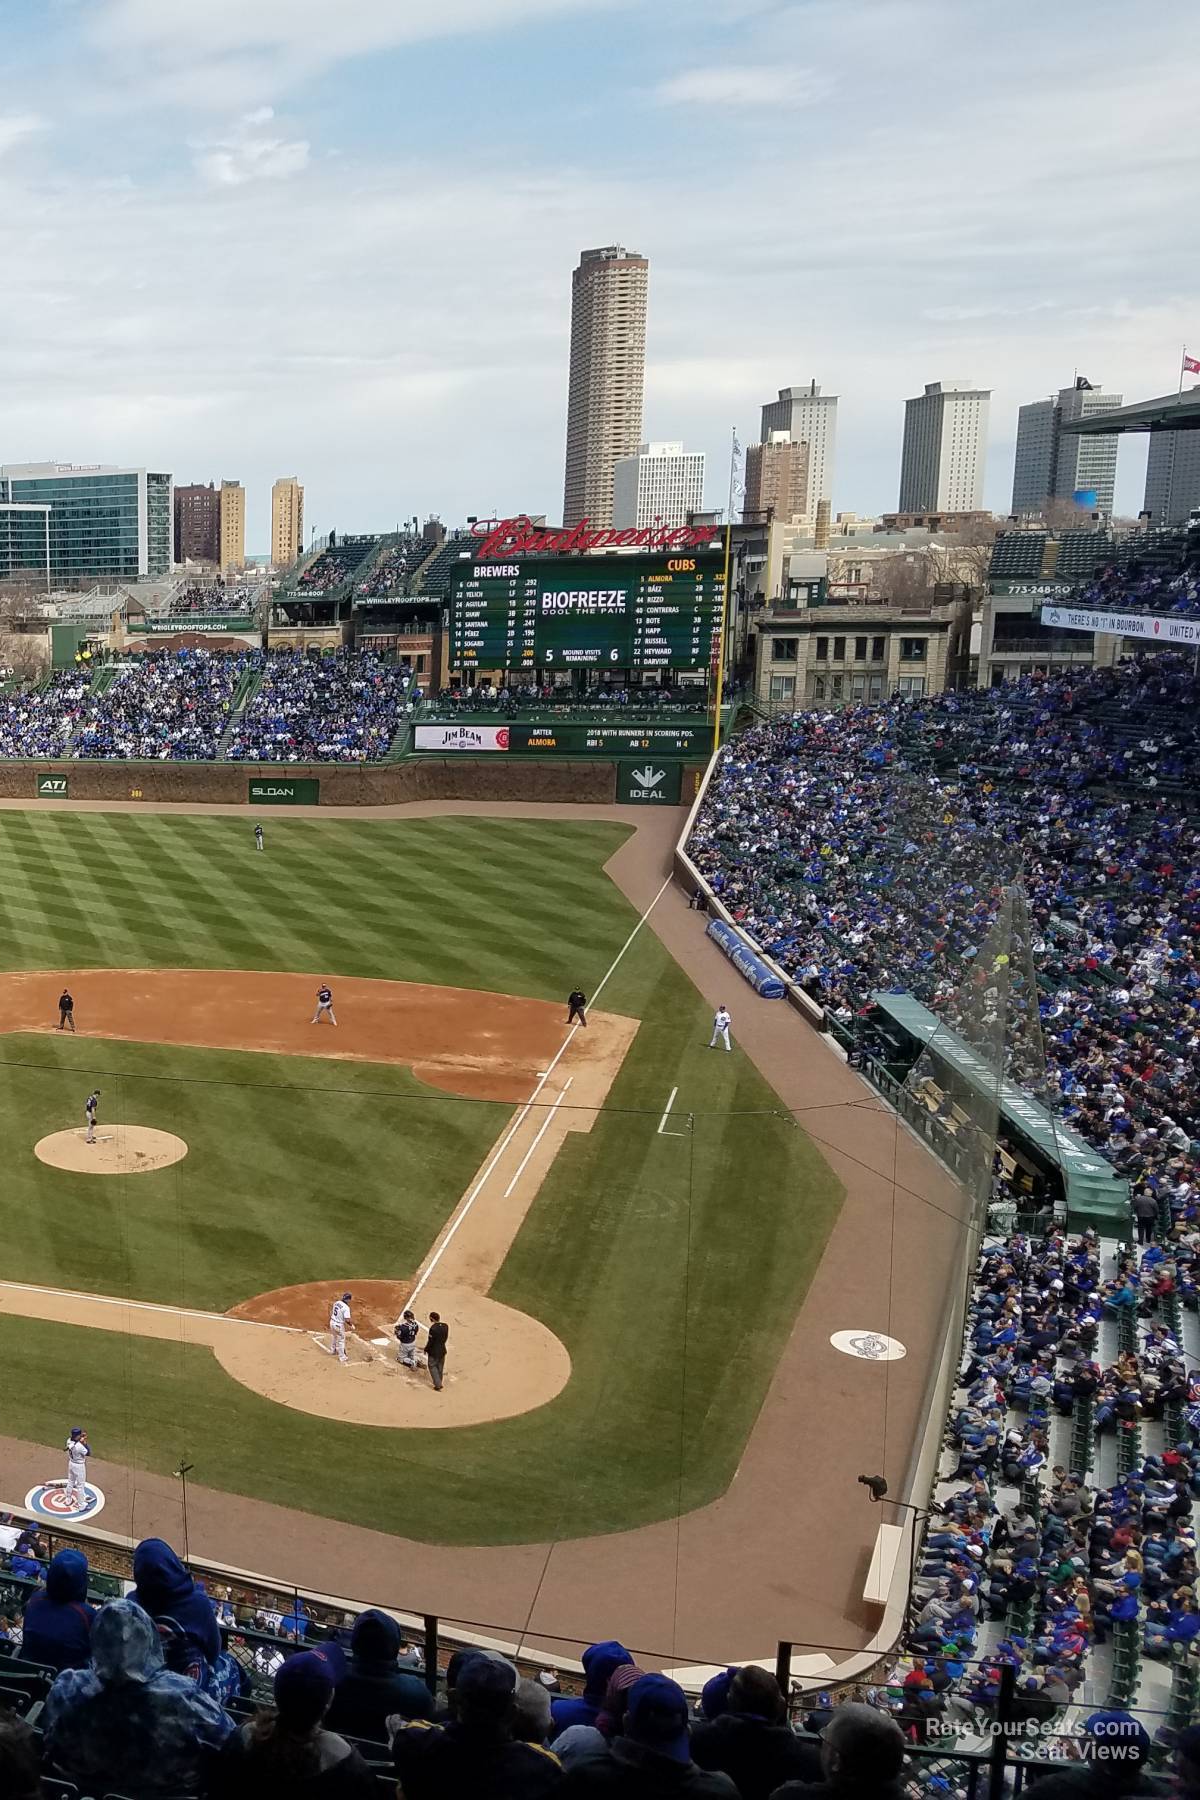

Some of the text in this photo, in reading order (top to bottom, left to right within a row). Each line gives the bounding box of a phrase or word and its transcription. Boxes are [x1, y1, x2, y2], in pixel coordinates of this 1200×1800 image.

[471, 515, 718, 559] Budweiser
[473, 565, 520, 577] BREWERS
[667, 559, 696, 571] CUBS
[542, 590, 626, 608] BIOFREEZE
[1068, 614, 1090, 626] THERE'S
[1109, 619, 1116, 628] IN
[1116, 619, 1146, 633] BOURBON.
[1169, 625, 1193, 638] UNITED
[545, 649, 554, 662] 5
[610, 648, 619, 661] 6
[442, 727, 482, 744] JIM BEAM
[528, 738, 556, 746] ALMORA
[40, 780, 66, 790] ATI
[252, 787, 294, 796] SLOAN
[630, 789, 667, 799] IDEAL
